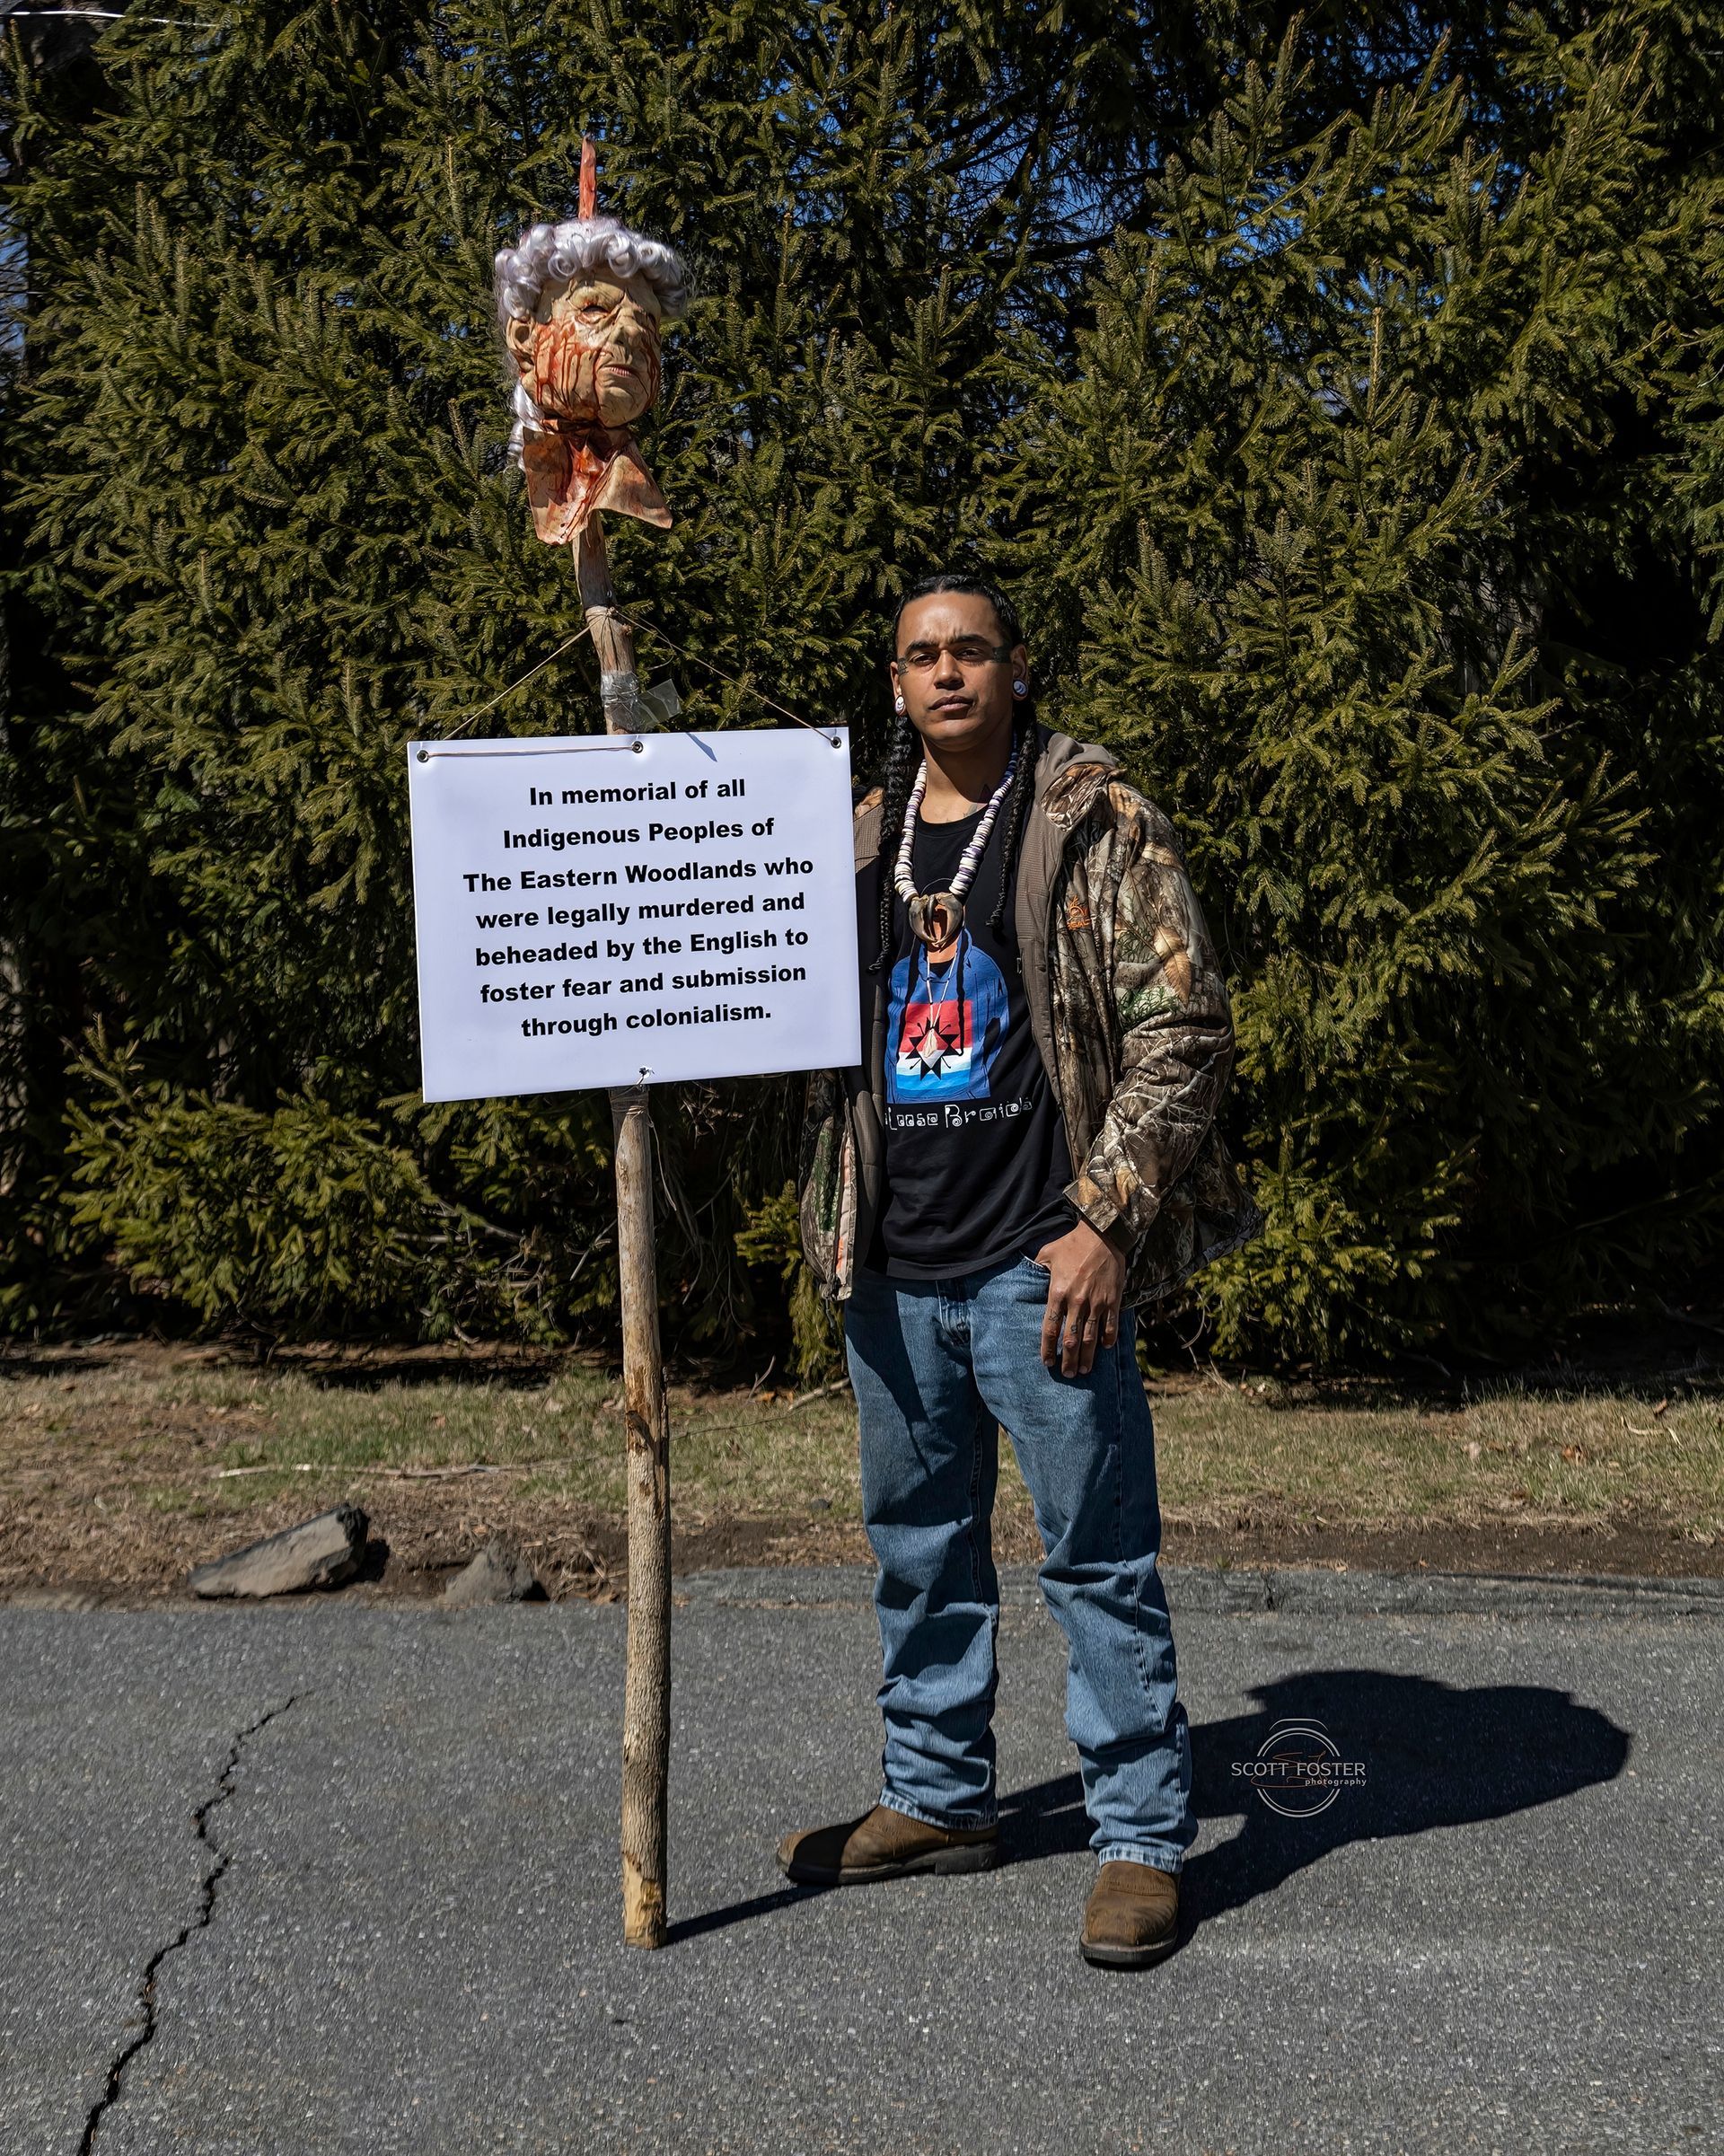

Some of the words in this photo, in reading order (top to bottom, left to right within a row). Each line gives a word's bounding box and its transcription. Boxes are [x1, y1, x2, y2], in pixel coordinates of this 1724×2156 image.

[531, 788, 552, 805] In
[562, 782, 676, 804] memorial
[685, 780, 708, 798] of
[717, 779, 745, 797] all
[504, 829, 639, 850] Indigenous
[649, 821, 743, 843] Peoples
[752, 818, 775, 836] of
[463, 874, 512, 892] The
[521, 869, 618, 889] Eastern
[625, 860, 757, 883] Woodlands
[764, 858, 814, 876] who
[476, 912, 539, 928] were
[548, 903, 630, 928] legally
[639, 895, 753, 919] murdered
[762, 892, 805, 911] and
[476, 941, 598, 966] beheaded
[607, 939, 635, 961] by
[643, 937, 682, 955] the
[690, 929, 777, 955] English
[785, 928, 809, 946] to
[480, 982, 555, 1003] foster
[562, 979, 611, 997] fear
[620, 972, 664, 993] and
[673, 964, 806, 989] submission
[522, 1013, 617, 1036] through
[627, 1004, 771, 1028] colonialism.
